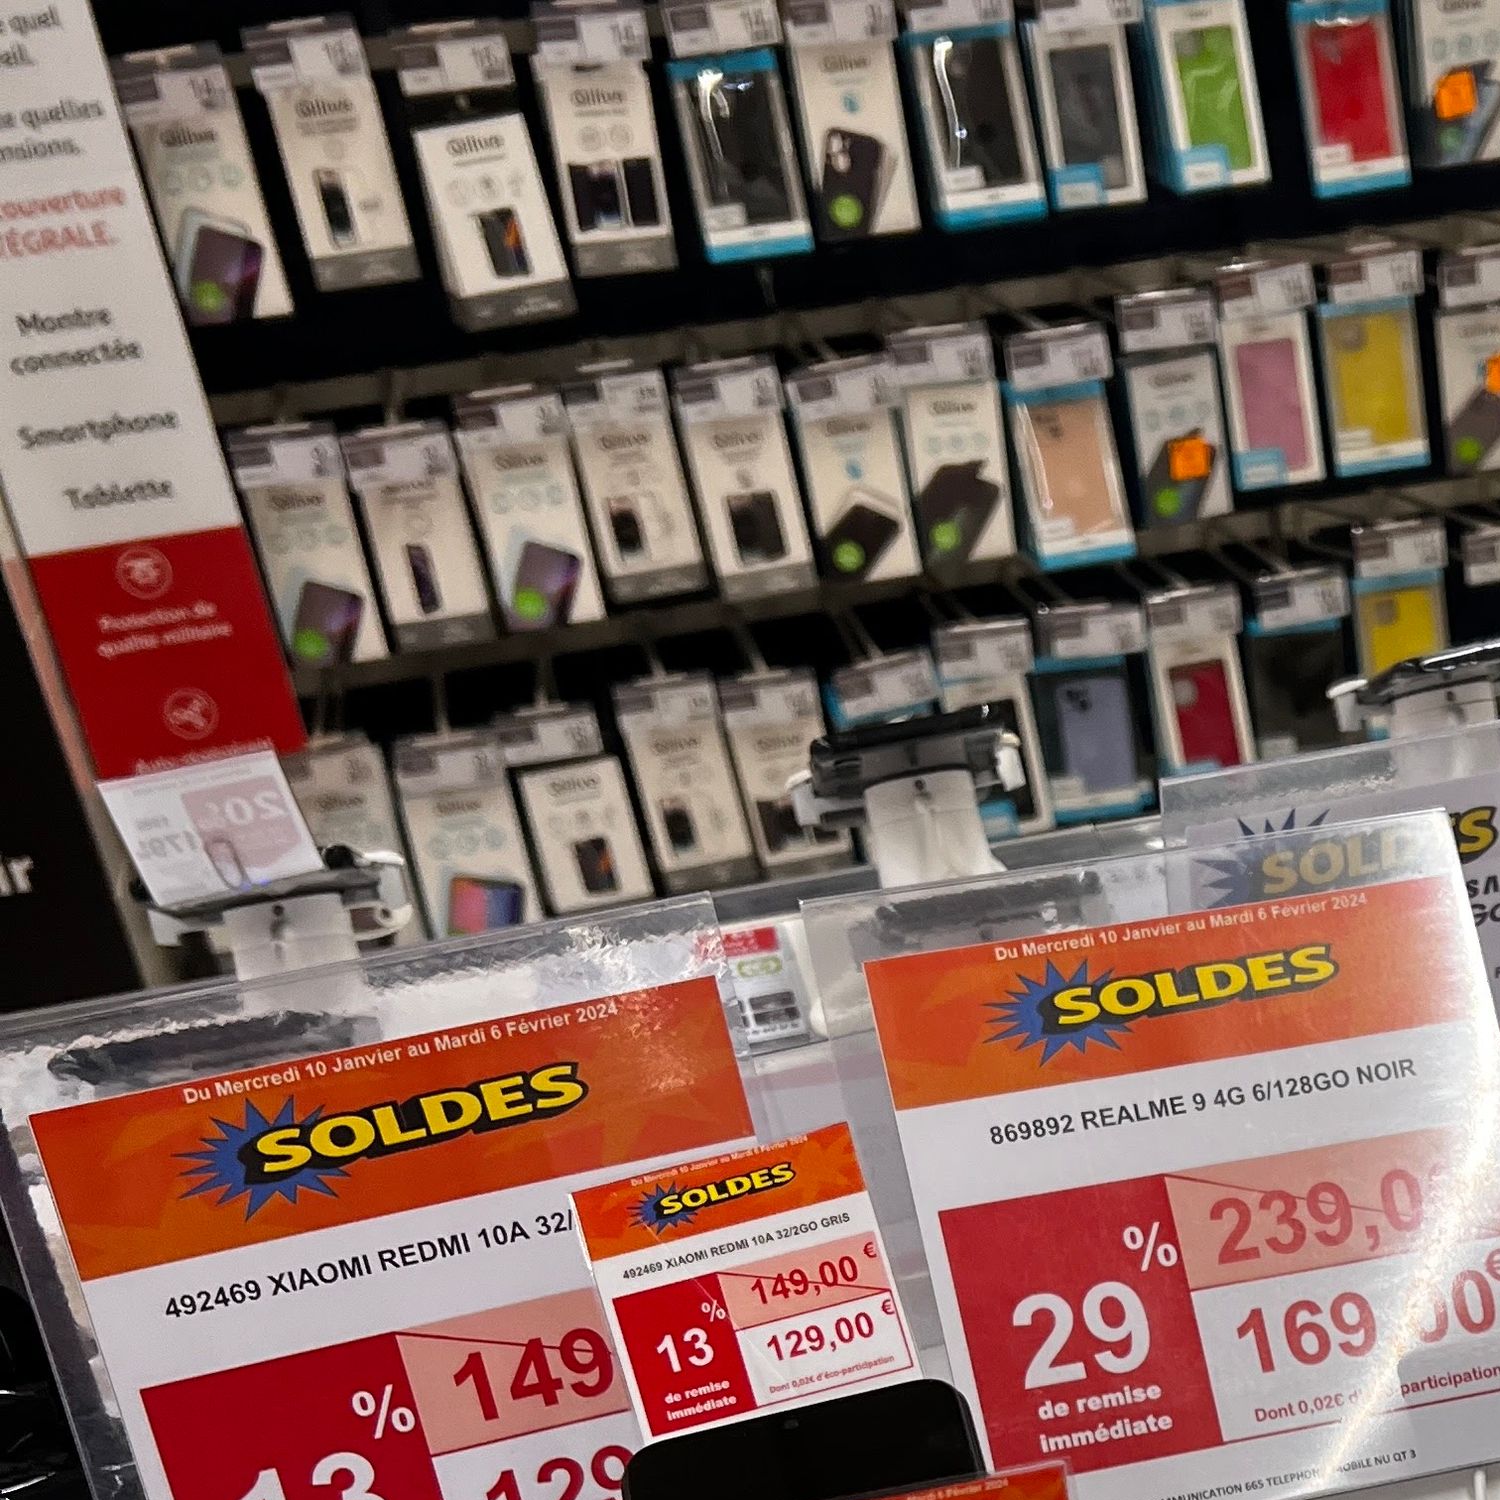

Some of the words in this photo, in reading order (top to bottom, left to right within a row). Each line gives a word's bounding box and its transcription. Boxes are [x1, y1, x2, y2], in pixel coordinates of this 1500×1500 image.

[15, 304, 113, 335] Montre
[19, 408, 178, 450] Smartphone
[65, 477, 173, 513] Tablette
[1052, 945, 1336, 1025] SOLDES
[184, 1084, 211, 1104] Du
[216, 1066, 300, 1100] Mercredi
[305, 1061, 326, 1078] 10
[332, 1046, 401, 1072] Janvier
[408, 1041, 429, 1056] au
[433, 1029, 484, 1052] Mardi
[489, 1026, 502, 1042] 6
[505, 1010, 571, 1036] Février
[576, 1002, 618, 1024] 2024
[256, 1062, 589, 1174] SOLDES
[991, 1114, 1075, 1145] 869892
[1081, 1095, 1186, 1130] REALME
[1193, 1092, 1206, 1113] 9
[1213, 1085, 1245, 1107] 4G
[1252, 1070, 1349, 1104] 6/128GO
[1357, 1059, 1415, 1087] NOIR
[661, 1162, 795, 1214] SOLDES
[165, 1280, 261, 1319] 492469
[268, 1253, 374, 1296] XIAOMI
[379, 1233, 471, 1270] REDMI
[478, 1221, 530, 1248] 10A
[536, 1211, 572, 1238] 32/
[623, 1262, 662, 1280] 492469
[666, 1251, 708, 1271] XIAOMI
[711, 1240, 749, 1258] REDMI
[752, 1233, 774, 1247] 10A
[777, 1222, 818, 1241] 32/2GO
[821, 1212, 850, 1228] GRIS
[1122, 1221, 1179, 1271] %
[751, 1256, 858, 1305] 149,00
[656, 1328, 714, 1373] 13
[767, 1312, 873, 1360] 129,00
[1012, 1281, 1151, 1391] 29
[453, 1326, 616, 1422] 149
[352, 1384, 416, 1438] %
[1038, 1400, 1070, 1420] de
[1076, 1383, 1162, 1412] remise
[1039, 1412, 1173, 1452] immédiate
